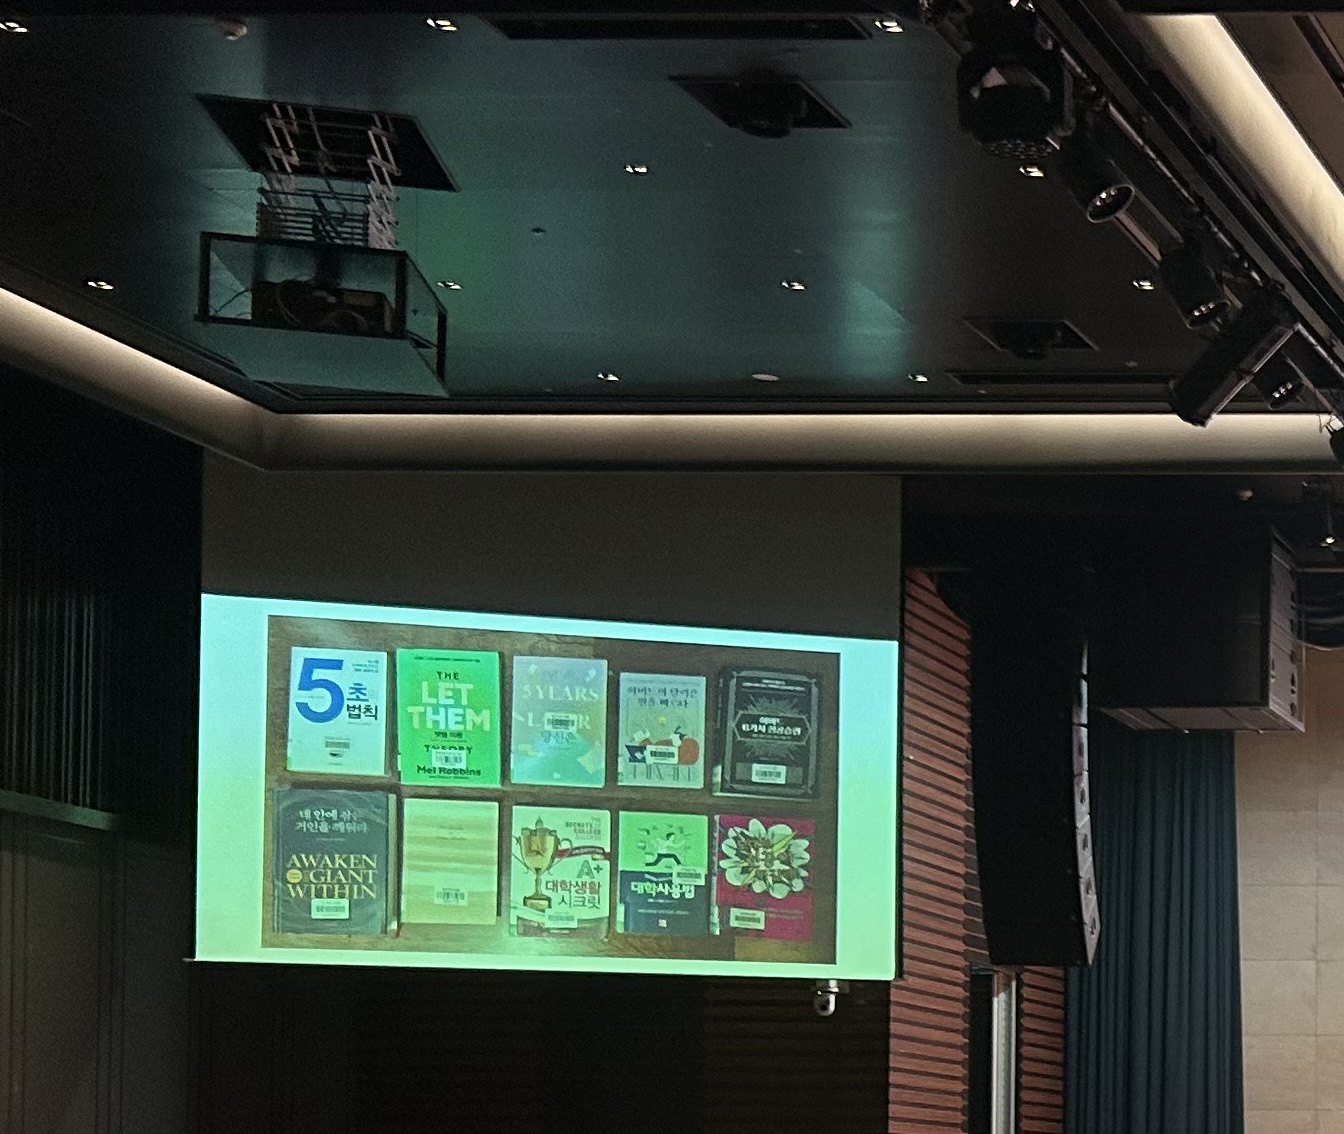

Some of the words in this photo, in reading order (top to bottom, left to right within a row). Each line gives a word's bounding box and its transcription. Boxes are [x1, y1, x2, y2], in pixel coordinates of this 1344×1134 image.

[437, 671, 459, 680] THE
[296, 658, 344, 723] 5
[421, 681, 473, 705] LET
[407, 706, 491, 731] THEM
[286, 854, 377, 869] AWAKEN
[309, 869, 378, 883] GIANT
[286, 883, 377, 899] WITHIN
[558, 895, 601, 909] 시크릿
